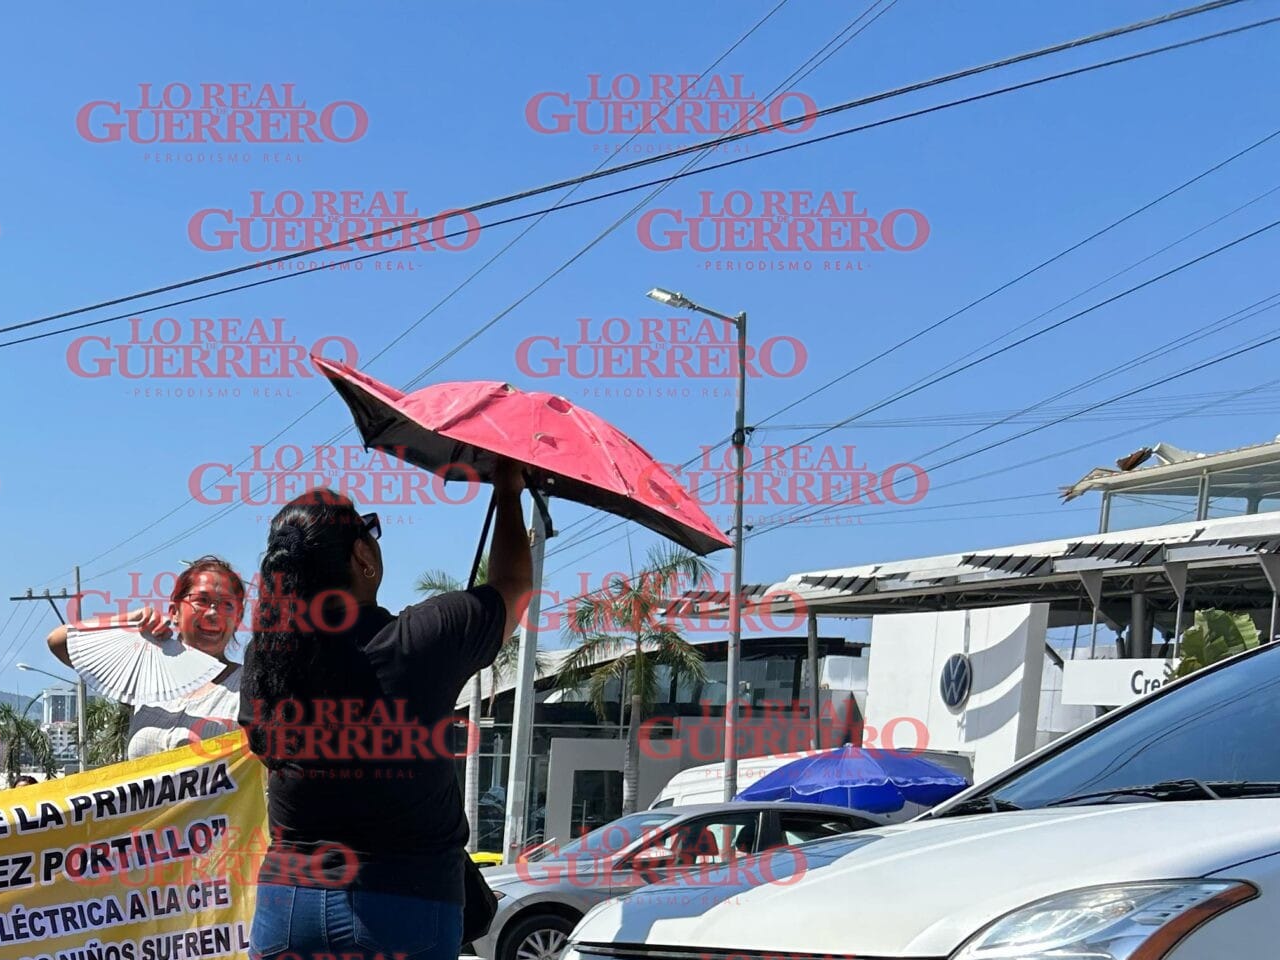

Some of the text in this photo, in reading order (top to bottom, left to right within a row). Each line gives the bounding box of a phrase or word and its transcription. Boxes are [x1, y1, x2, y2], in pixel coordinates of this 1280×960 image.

[15, 803, 64, 831] LA
[71, 764, 234, 822] PRIMARIA
[130, 893, 148, 919] A
[151, 888, 181, 915] LA
[187, 880, 228, 909] CFE
[238, 924, 250, 950] SUFREN
